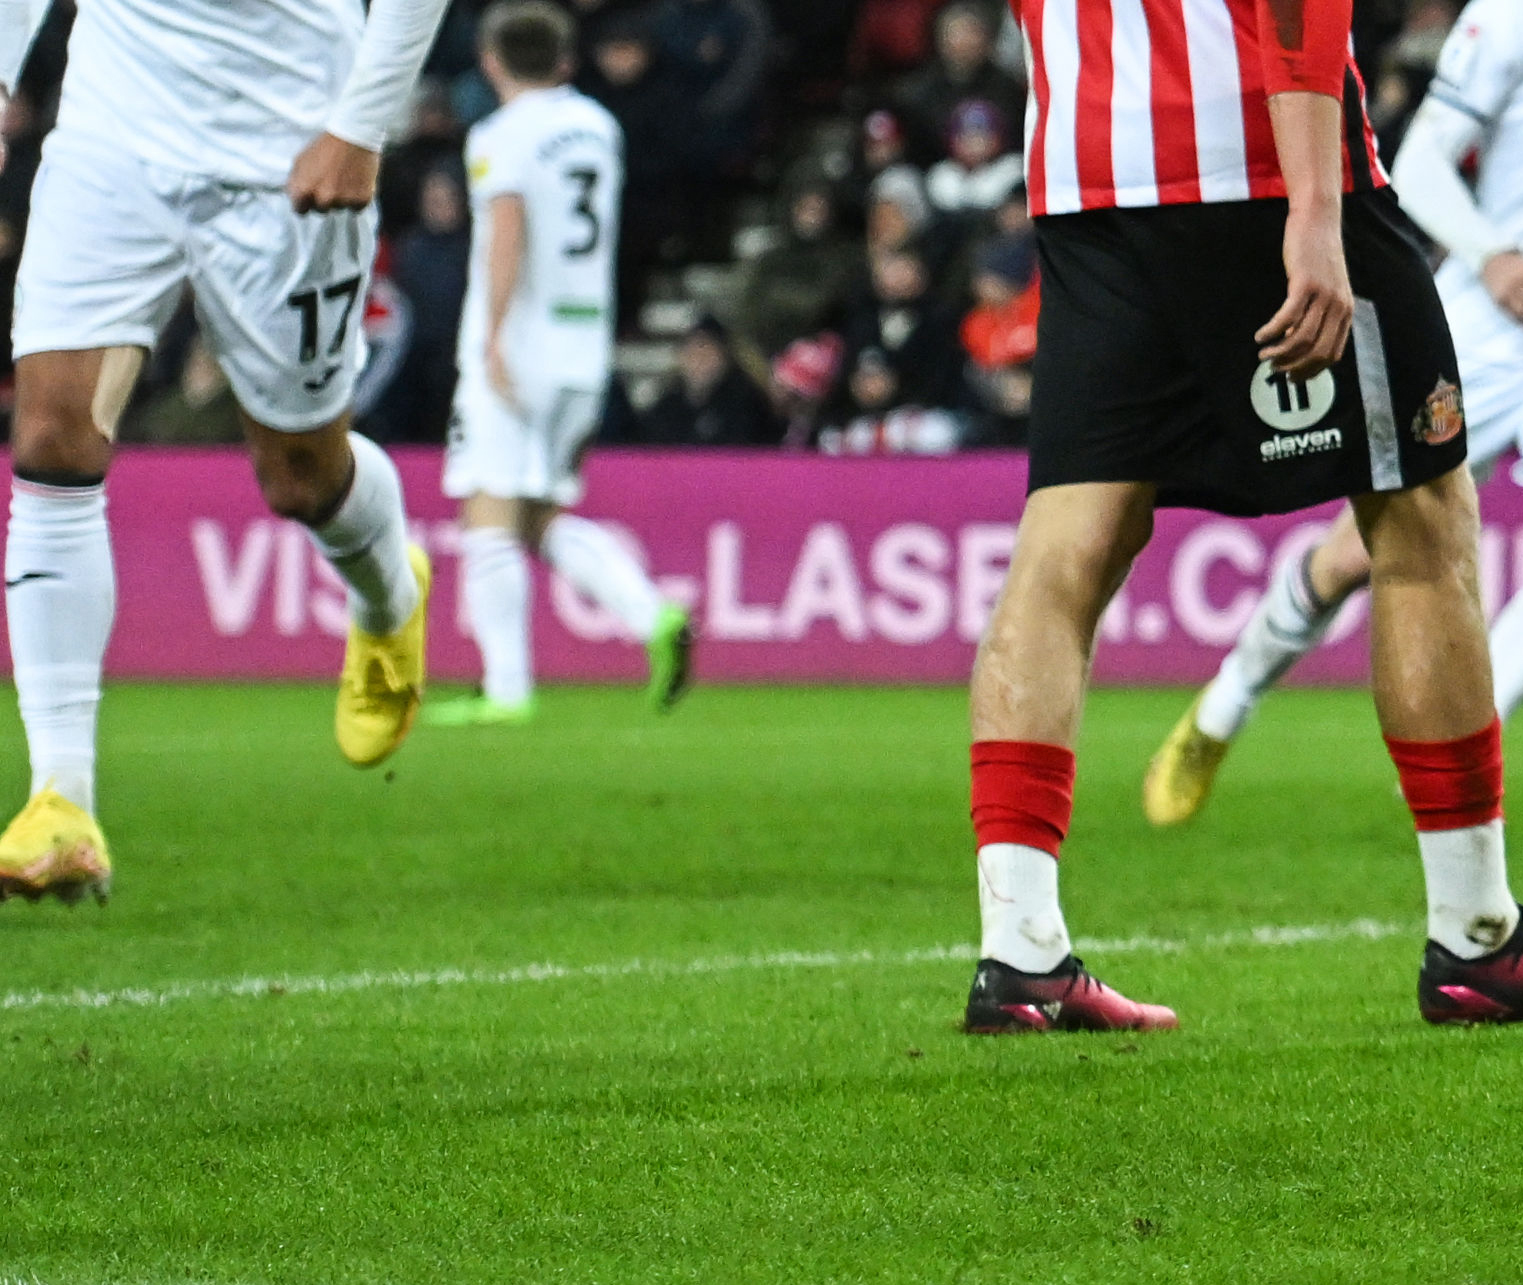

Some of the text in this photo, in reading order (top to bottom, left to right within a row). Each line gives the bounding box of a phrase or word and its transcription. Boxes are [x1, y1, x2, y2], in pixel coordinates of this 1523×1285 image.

[561, 164, 602, 259] 3
[287, 273, 361, 365] 17
[1260, 428, 1342, 457] eleven
